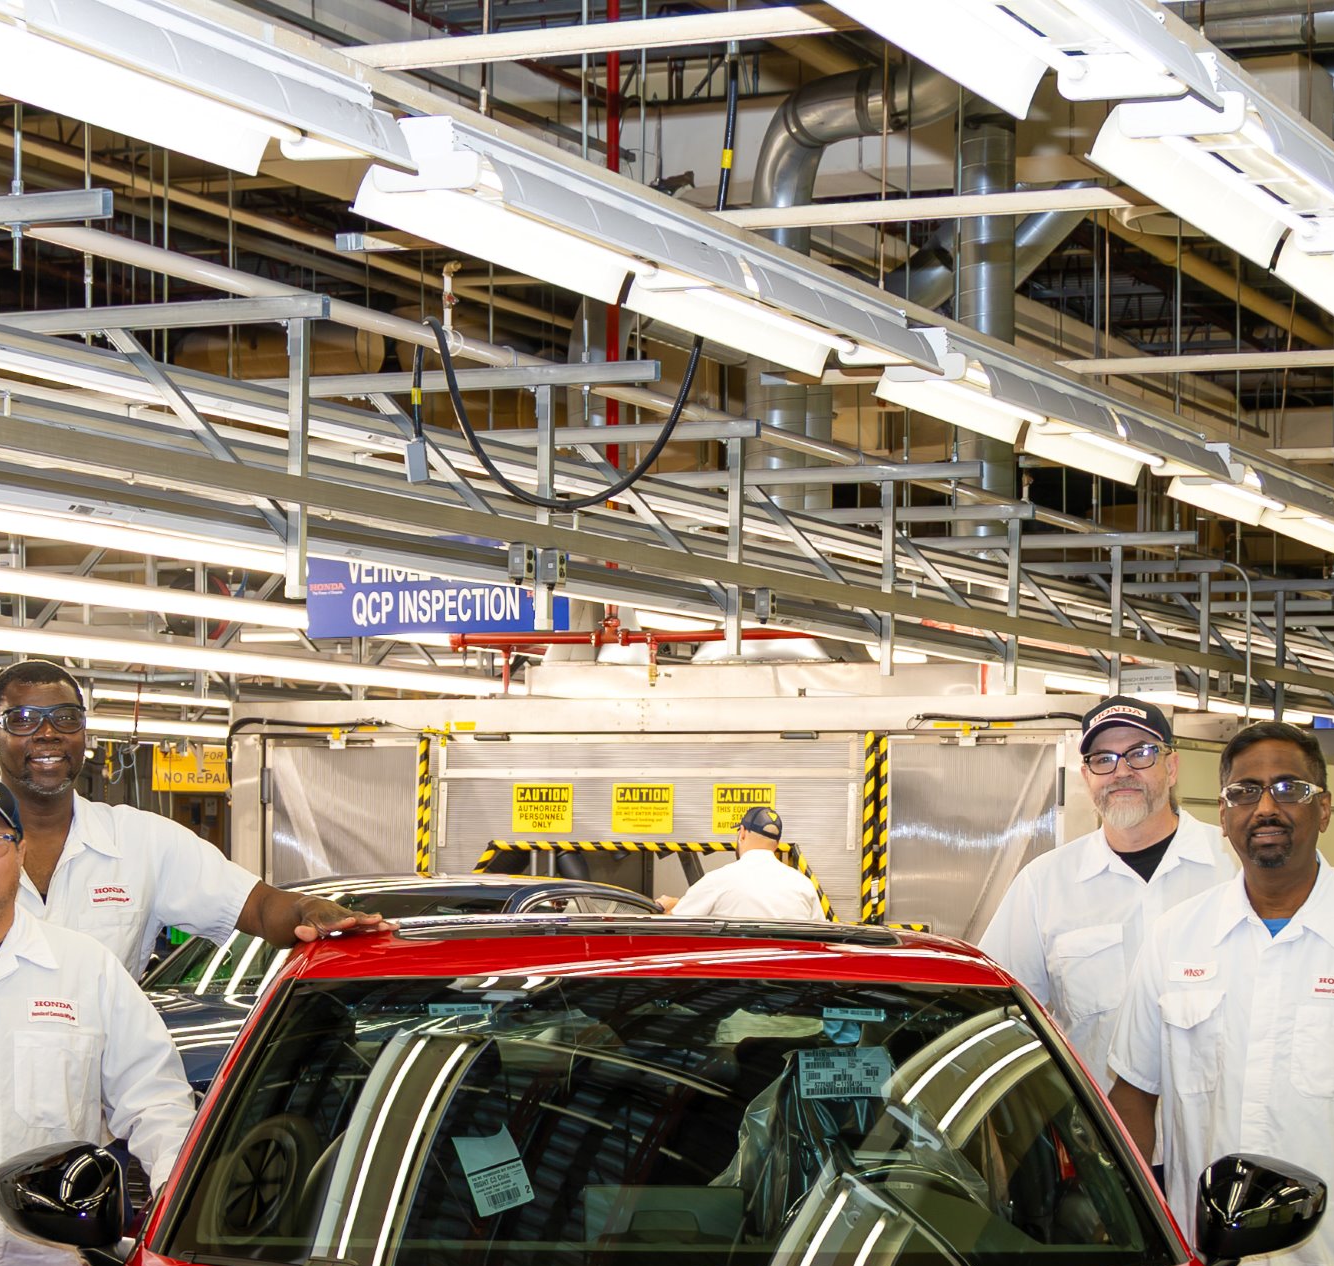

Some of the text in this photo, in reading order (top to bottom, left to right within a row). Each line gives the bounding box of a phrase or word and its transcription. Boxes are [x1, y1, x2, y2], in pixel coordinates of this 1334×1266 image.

[309, 582, 346, 591] HONDA
[352, 587, 520, 627] QCP INSPECTION
[1093, 705, 1142, 723] HONDA
[203, 751, 224, 761] FOR
[164, 772, 183, 784] NO
[517, 788, 568, 801] CAUTION
[617, 788, 669, 802] CAUTION
[717, 789, 771, 802] CAUTION
[519, 813, 565, 821] PERSONNEL
[531, 821, 552, 829] ONLY
[33, 1001, 73, 1011] HONDA
[524, 1185, 532, 1194] 2
